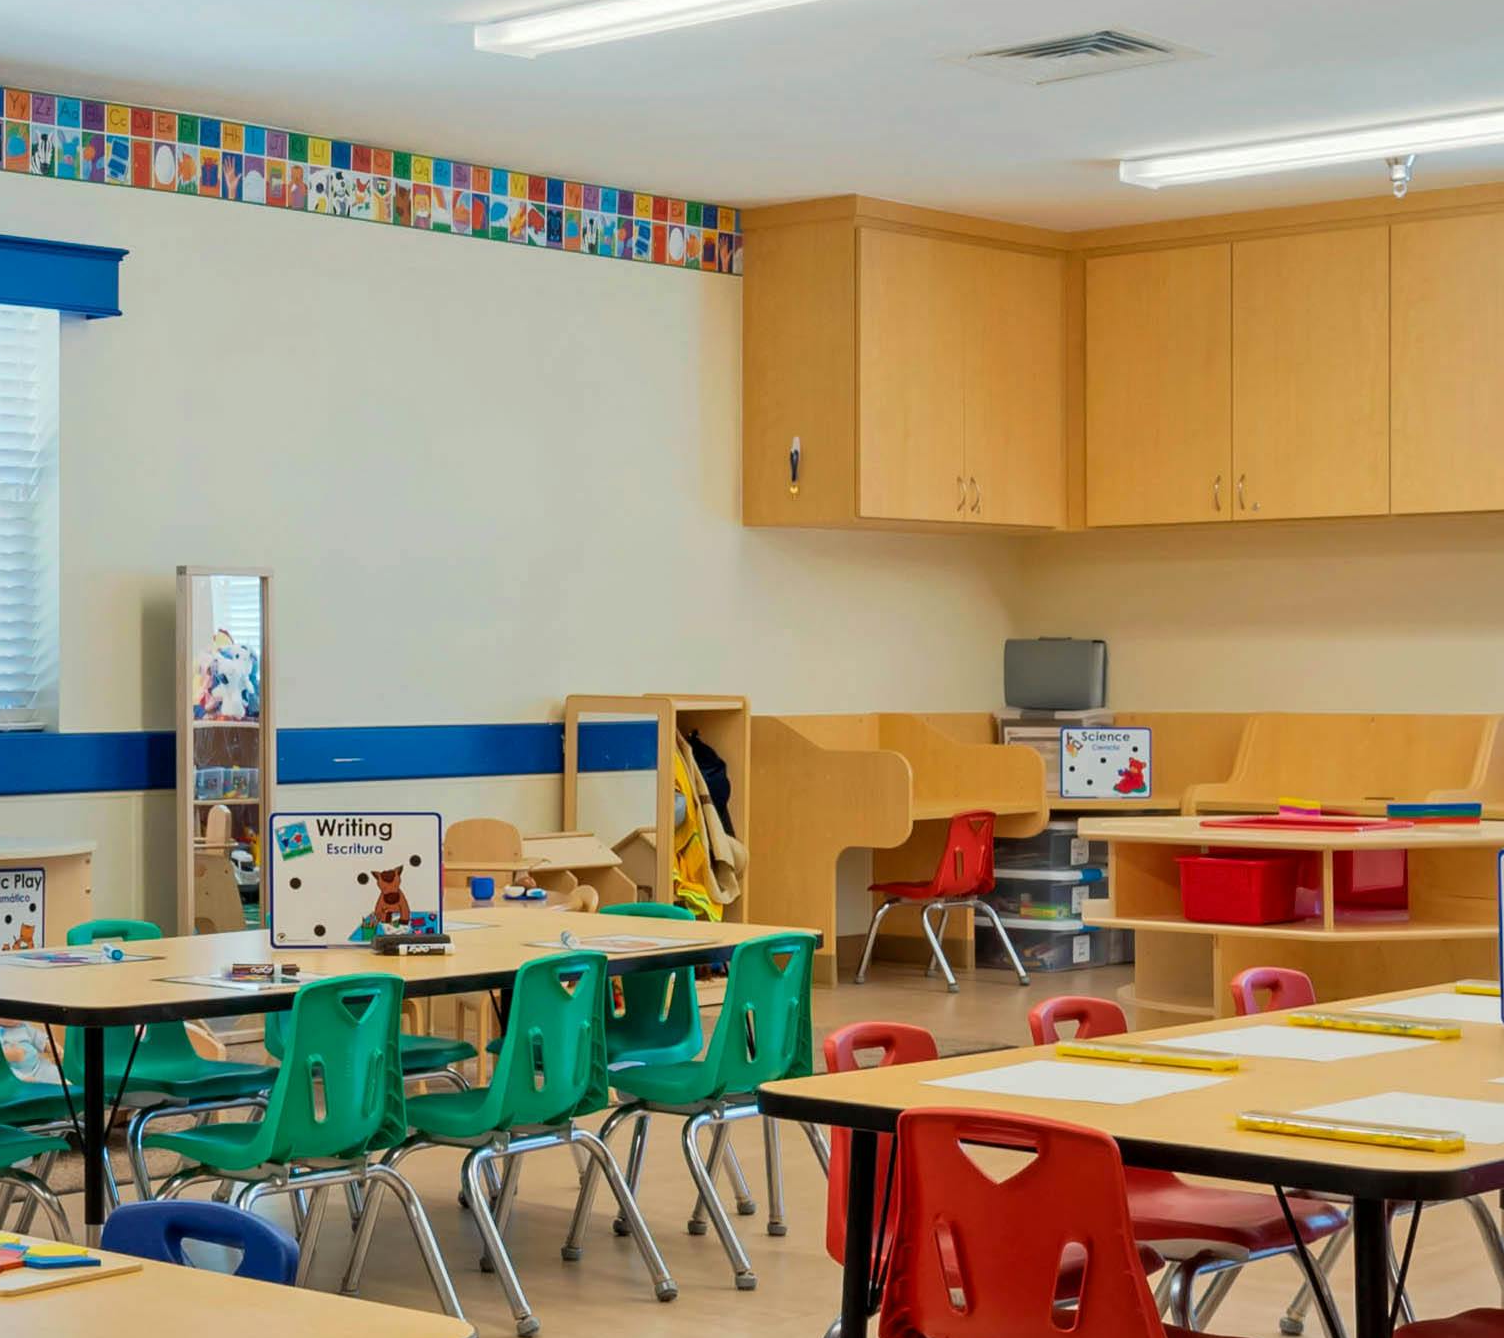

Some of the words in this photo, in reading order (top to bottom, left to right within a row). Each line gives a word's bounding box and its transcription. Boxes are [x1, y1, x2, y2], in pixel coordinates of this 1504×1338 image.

[1081, 731, 1130, 742] Science
[316, 819, 392, 841] Writing
[327, 843, 383, 854] Escritura
[14, 874, 42, 892] Play
